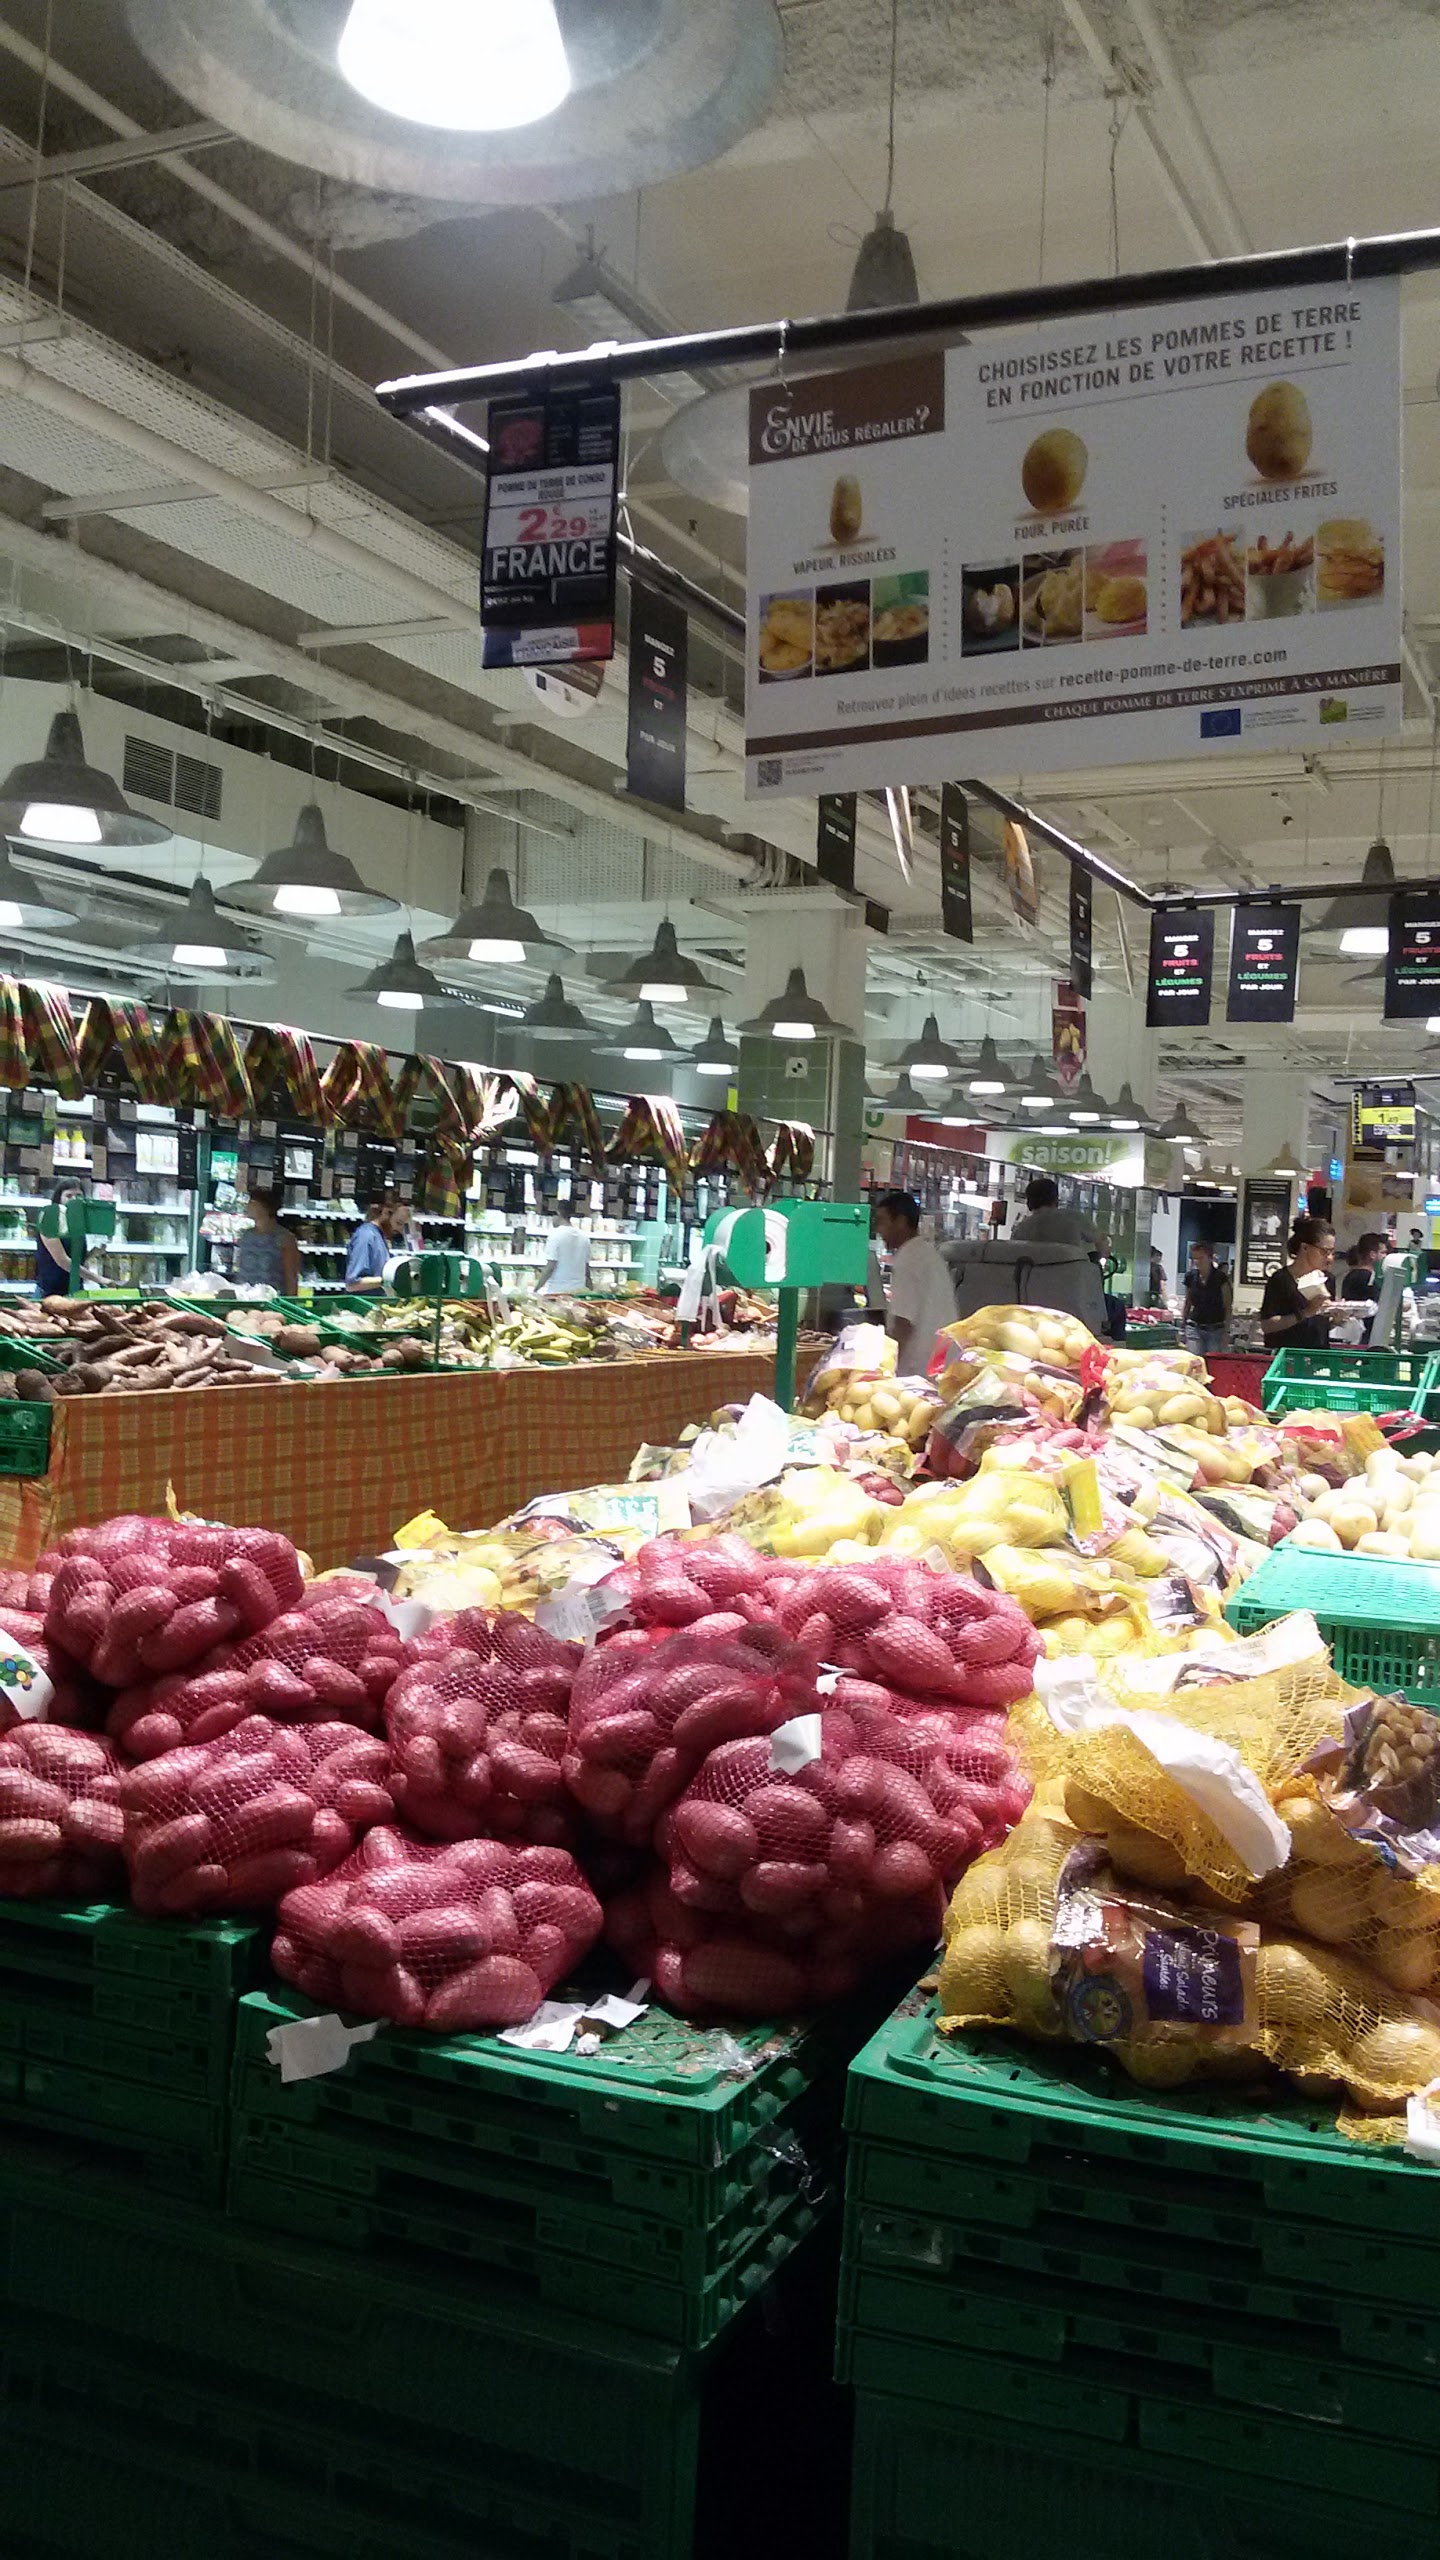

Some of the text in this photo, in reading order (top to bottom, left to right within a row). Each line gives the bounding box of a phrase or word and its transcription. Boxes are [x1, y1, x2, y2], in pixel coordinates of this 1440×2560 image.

[978, 301, 1362, 383] CHOISISSEZ LES POMMES DE TERRE
[986, 387, 1012, 408] EN
[1020, 369, 1121, 402] FONCTION
[1129, 360, 1155, 383] DE
[1164, 347, 1231, 378] VOTRE
[1240, 332, 1337, 364] RECETTE
[791, 436, 809, 452] DE
[813, 429, 850, 448] VOUS
[1223, 482, 1338, 510] SPÉCIALES FRITES
[1051, 516, 1090, 534] PURÉE
[491, 538, 607, 580] FRANCE
[652, 655, 667, 678] 5
[837, 649, 1288, 715] Retrouvez plein d'idées recettes sur recette-pomme-de-terre.com
[1043, 701, 1099, 719] CHAQUE
[1103, 696, 1152, 713] POMME
[1156, 693, 1173, 707] DE
[1177, 687, 1215, 705] TERRE
[1218, 681, 1287, 700] S'EXPRIME
[1304, 675, 1322, 690] SA
[1327, 667, 1390, 687] MANIÈRE
[1164, 935, 1199, 943] MANGEZ
[1257, 938, 1273, 951] 5
[1415, 931, 1431, 944] 5
[1173, 944, 1189, 958] 5
[1245, 953, 1283, 961] FRUITS
[1162, 958, 1199, 967] FRUITS
[1415, 956, 1428, 964] ET
[1155, 977, 1204, 987] LÉGUMES
[1237, 971, 1288, 980] LÉGUMES
[1158, 989, 1176, 997] PAR
[1259, 983, 1284, 991] JOUR
[1021, 1140, 1112, 1165] saison!
[1197, 1927, 1219, 2020] Primeurs
